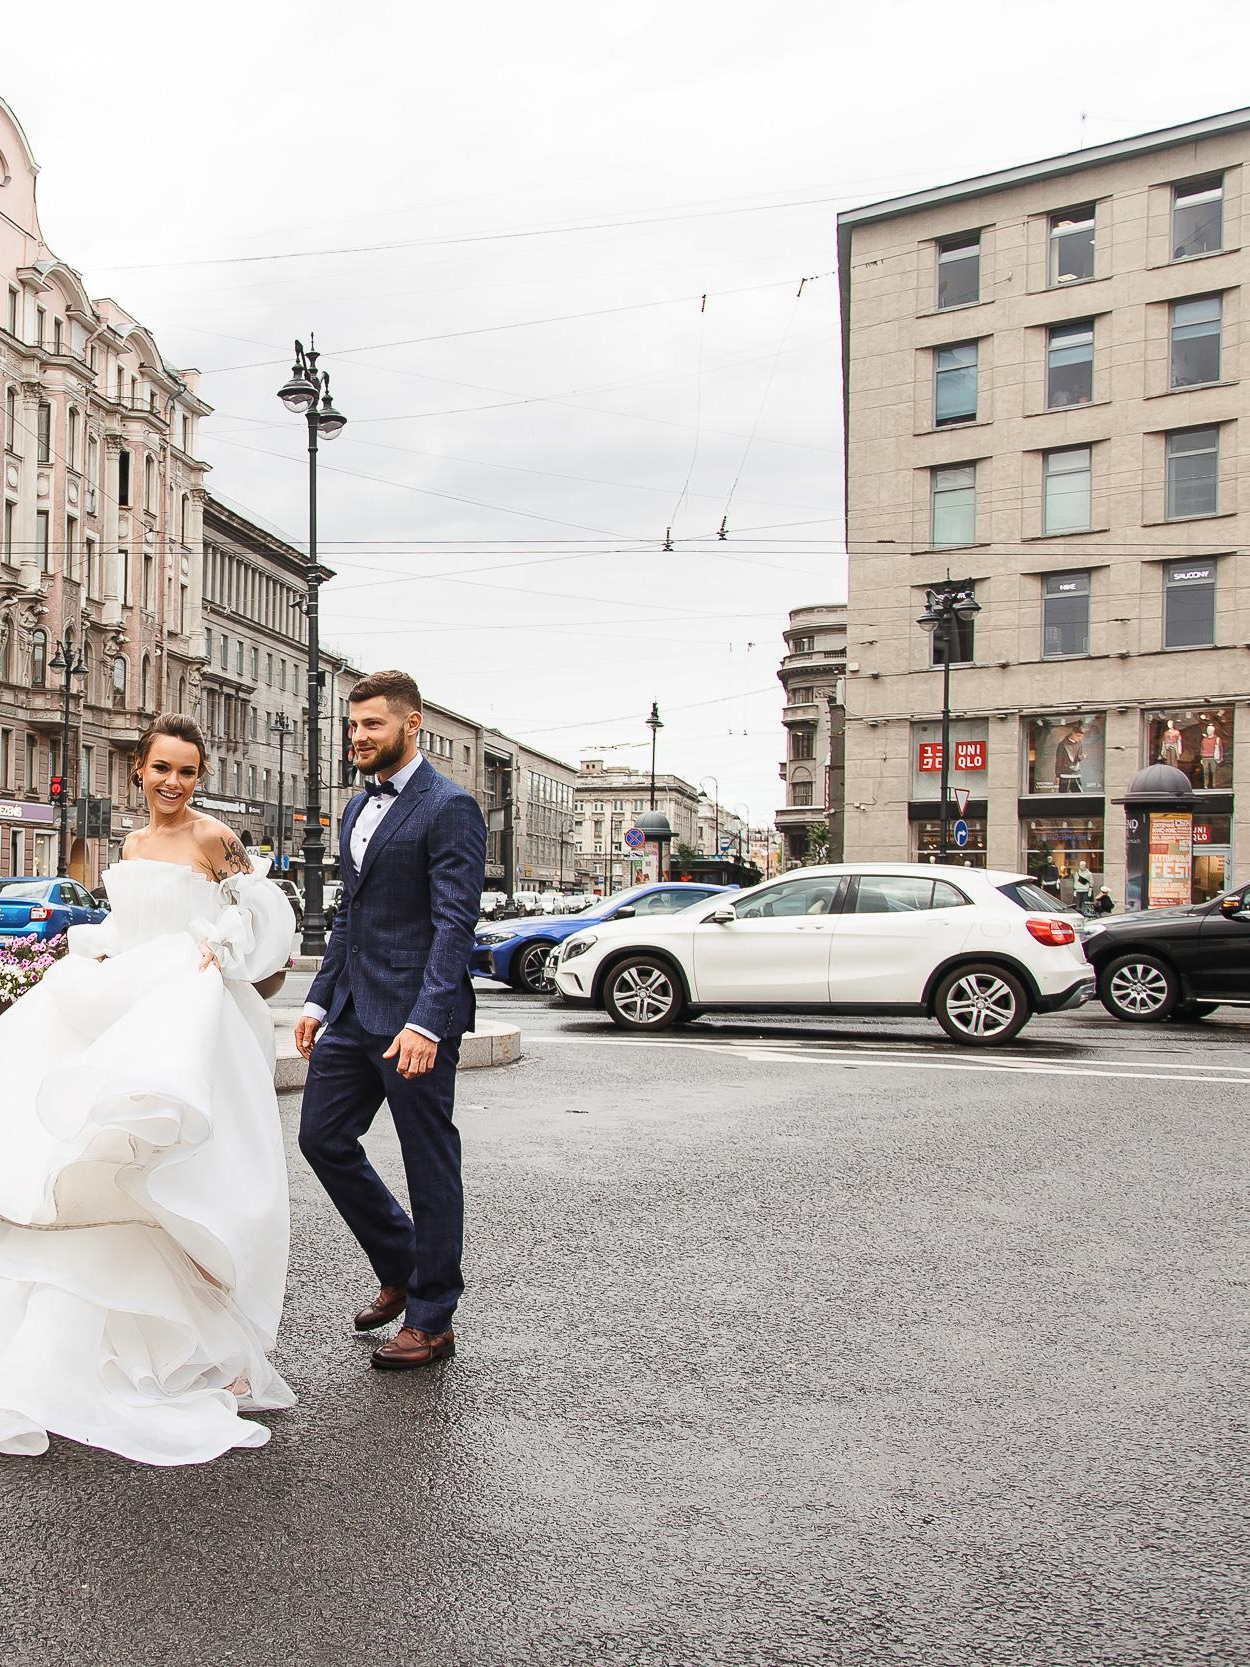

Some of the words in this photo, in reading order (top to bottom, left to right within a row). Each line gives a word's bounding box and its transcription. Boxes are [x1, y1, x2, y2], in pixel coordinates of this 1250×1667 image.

[1173, 570, 1209, 581] SAUCONY
[1059, 583, 1077, 591] NIKE
[958, 744, 981, 756] UNI
[957, 755, 982, 769] QLO
